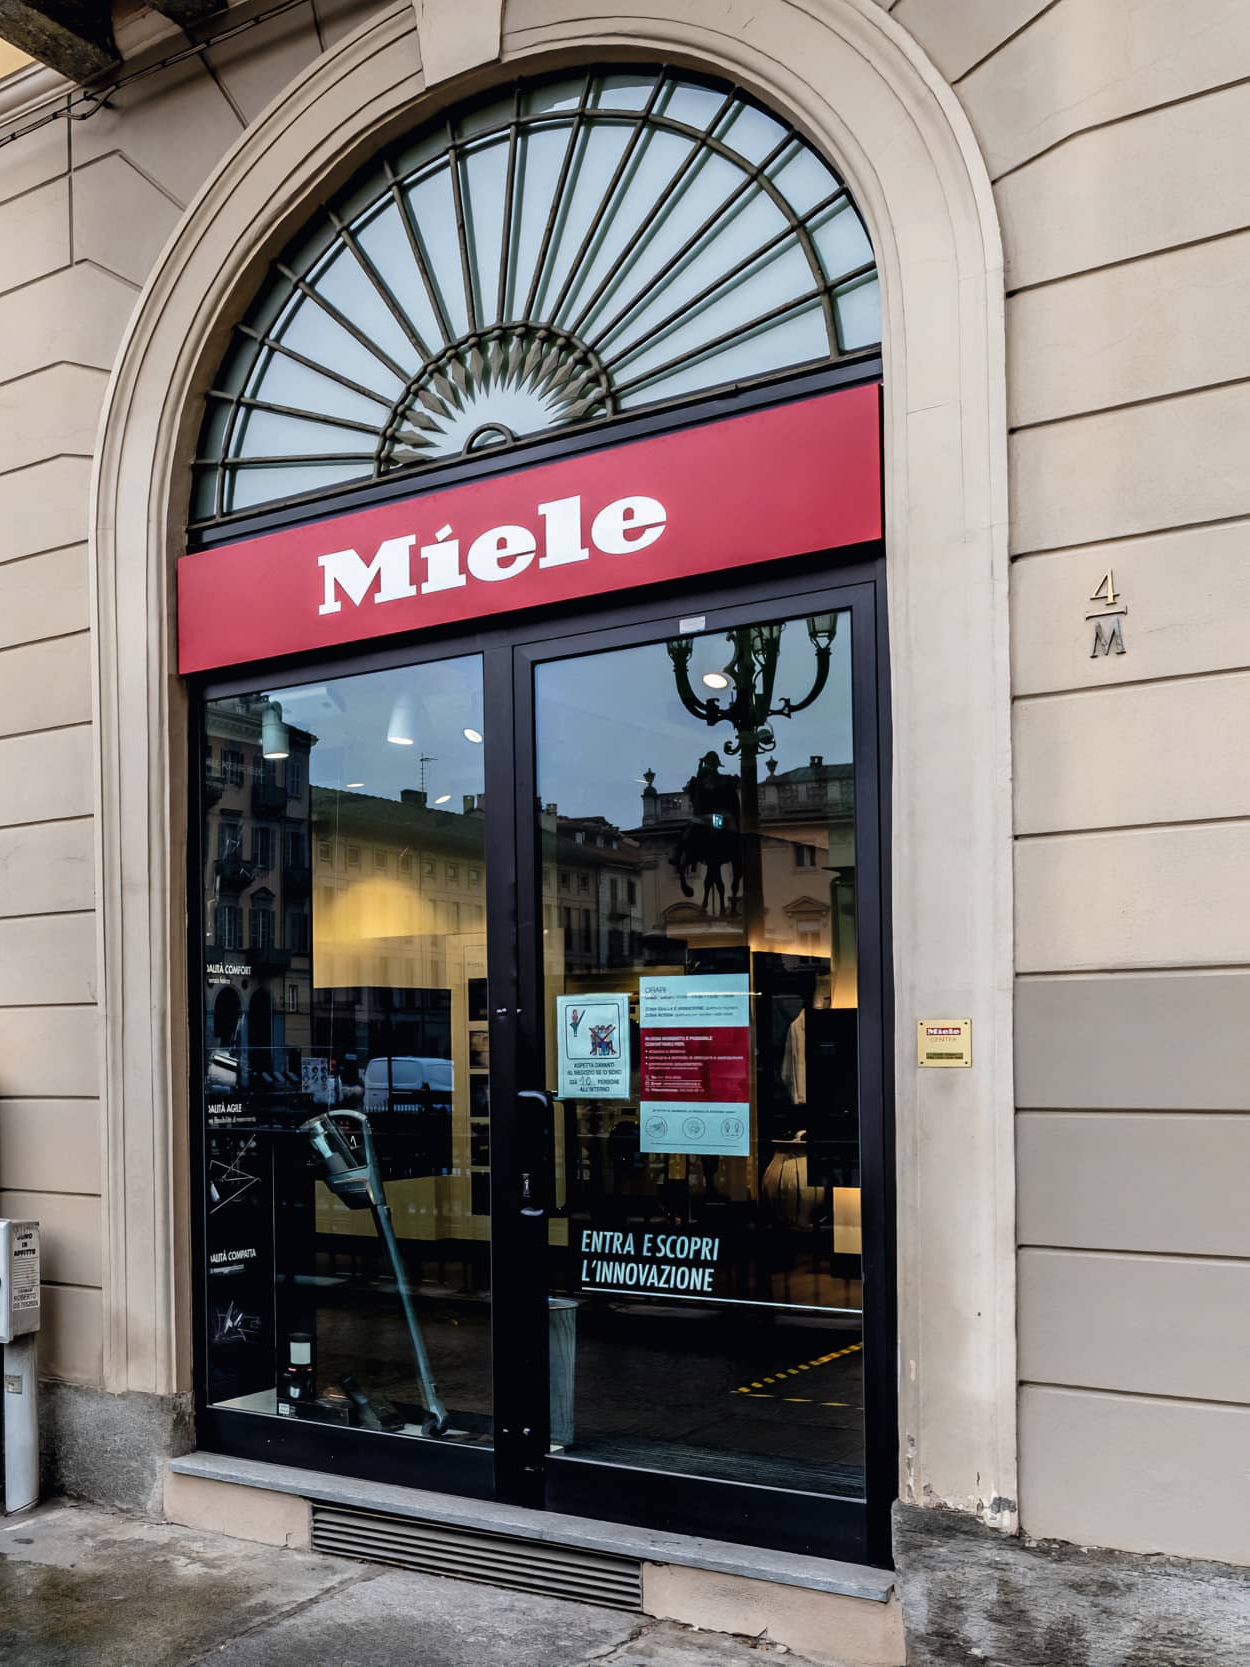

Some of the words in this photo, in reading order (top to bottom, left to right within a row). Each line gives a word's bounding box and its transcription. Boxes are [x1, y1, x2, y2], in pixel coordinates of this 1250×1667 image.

[317, 494, 667, 616] Miele
[1090, 568, 1120, 606] 4
[225, 964, 252, 976] COMFORT
[226, 1103, 242, 1113] AGILE
[227, 1248, 256, 1261] COMPATTA
[581, 1230, 635, 1255] ENTRA
[642, 1233, 653, 1256] E
[655, 1234, 719, 1261] SCOPRI
[581, 1259, 715, 1292] L'INNOVAZIONE
